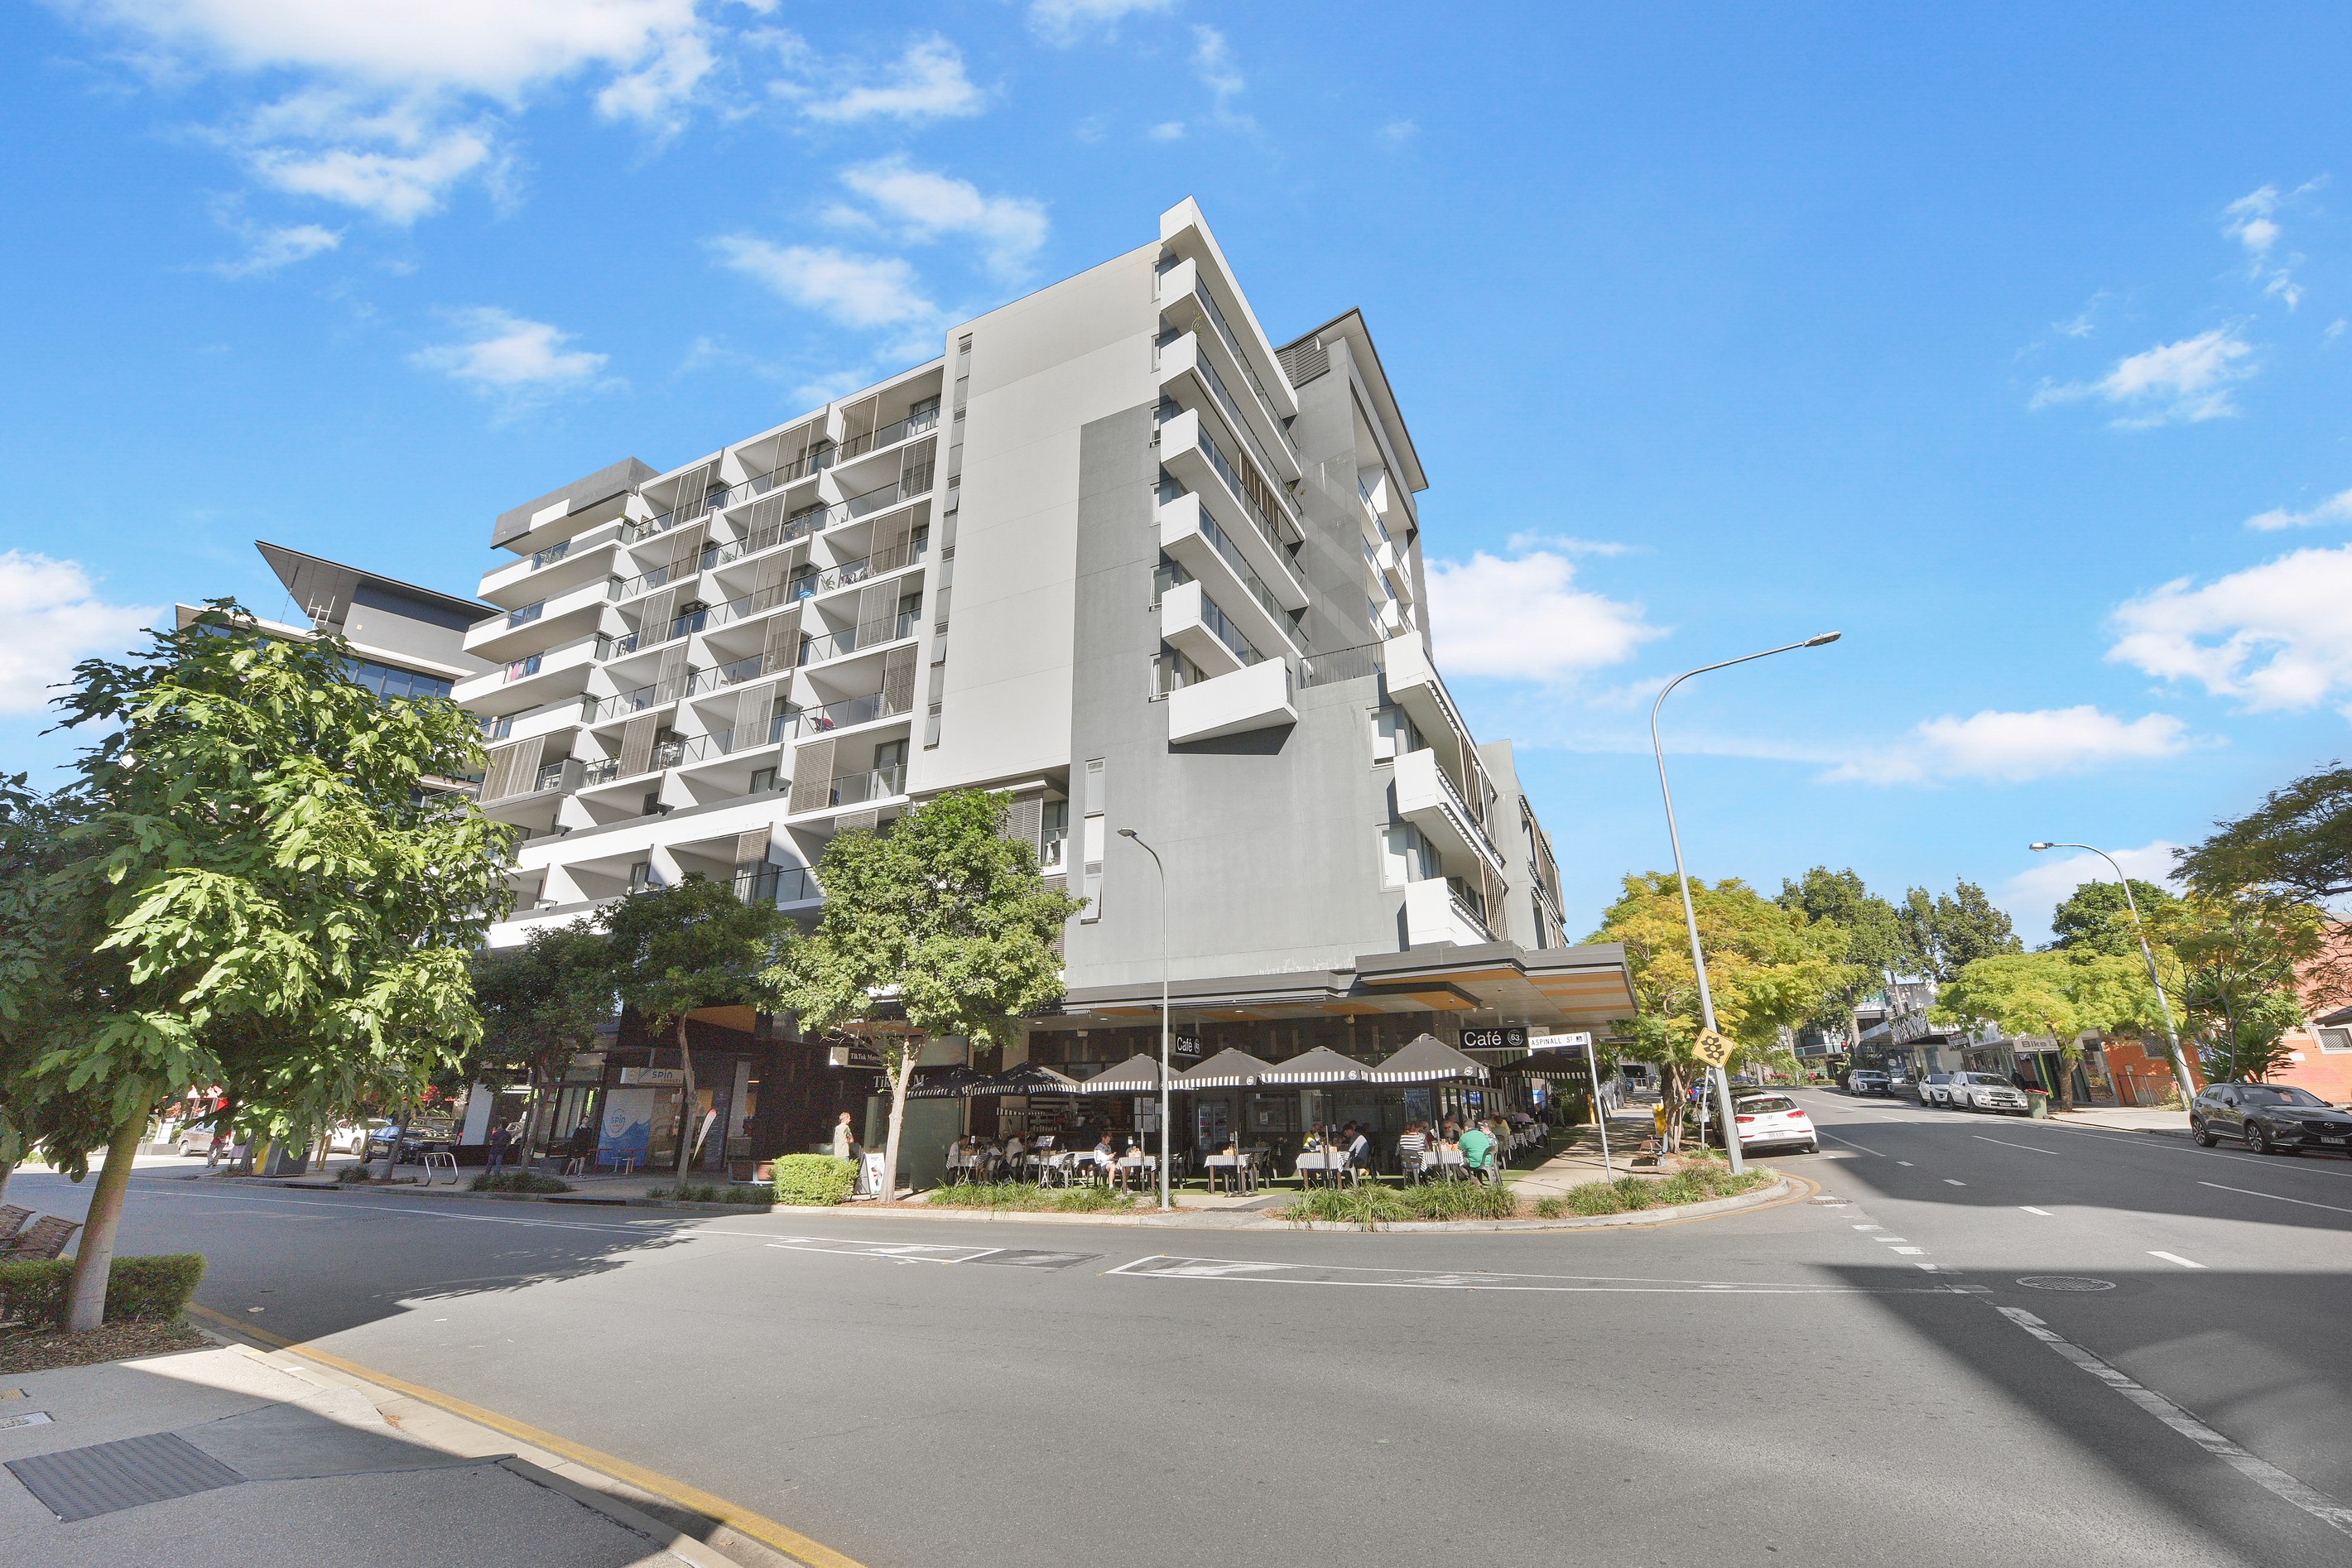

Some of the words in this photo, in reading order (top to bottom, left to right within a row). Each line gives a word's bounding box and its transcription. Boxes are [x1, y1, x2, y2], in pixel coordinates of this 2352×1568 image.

[1464, 1031, 1502, 1046] Café
[1511, 1033, 1520, 1041] 63
[1531, 1037, 1562, 1046] ASPINALL
[1176, 1037, 1193, 1052] Café
[2021, 1040, 2047, 1048] Bike
[850, 1052, 867, 1061] TikTok
